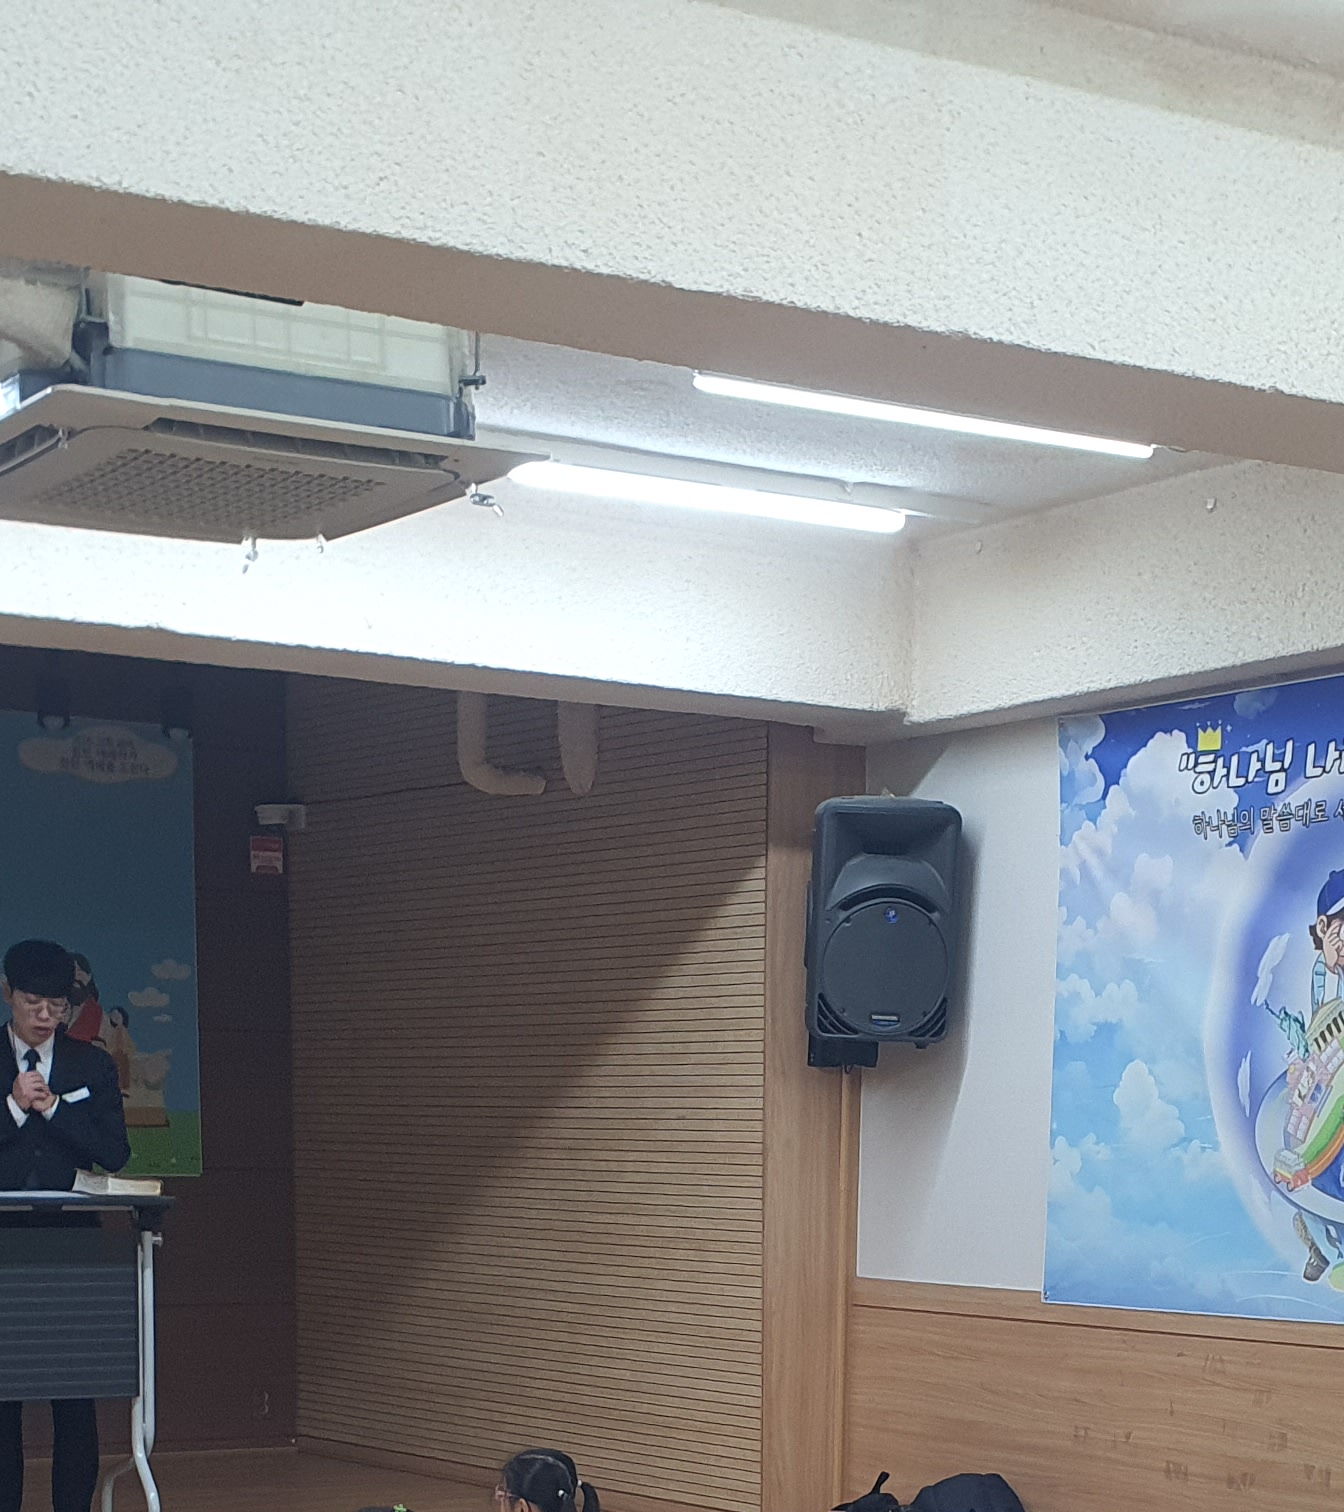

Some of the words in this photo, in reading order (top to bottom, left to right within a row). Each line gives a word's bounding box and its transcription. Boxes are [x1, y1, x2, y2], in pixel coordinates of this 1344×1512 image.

[1178, 740, 1294, 794] "하나님
[1192, 811, 1255, 841] 하나님의
[1259, 799, 1329, 835] 말씀대로
